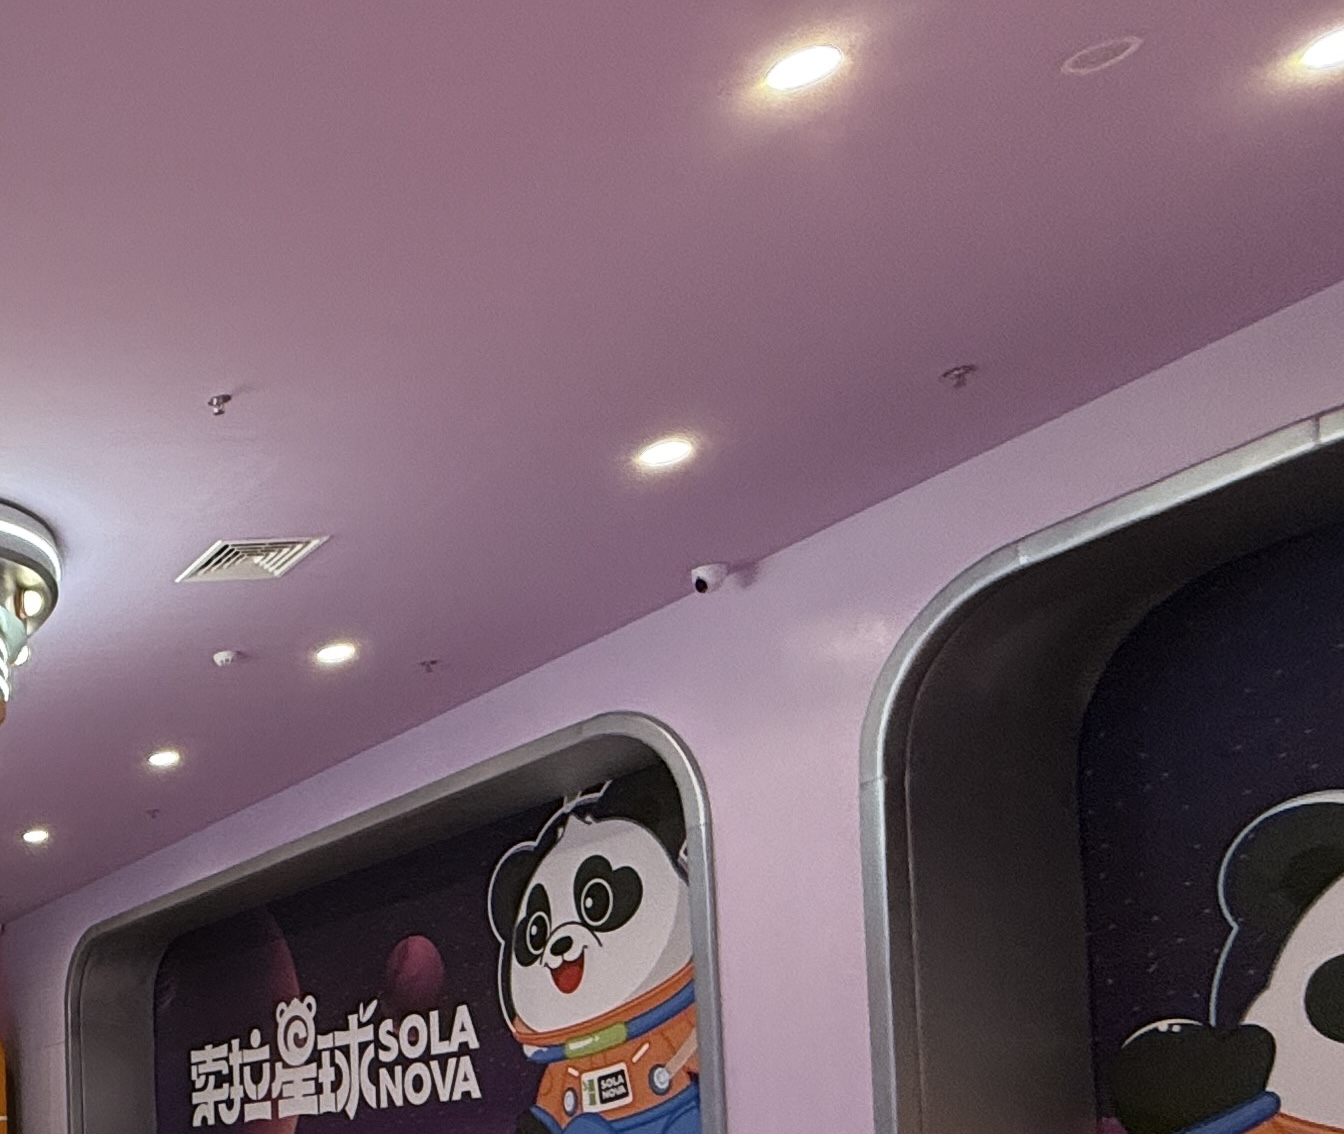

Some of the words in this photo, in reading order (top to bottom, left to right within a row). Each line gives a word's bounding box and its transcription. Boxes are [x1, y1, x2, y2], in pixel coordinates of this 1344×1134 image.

[378, 1004, 480, 1063] SOLA
[190, 995, 378, 1127] 索拉星球
[378, 1055, 482, 1109] NOVA
[600, 1074, 625, 1090] SOLA
[601, 1085, 627, 1100] NOVA
